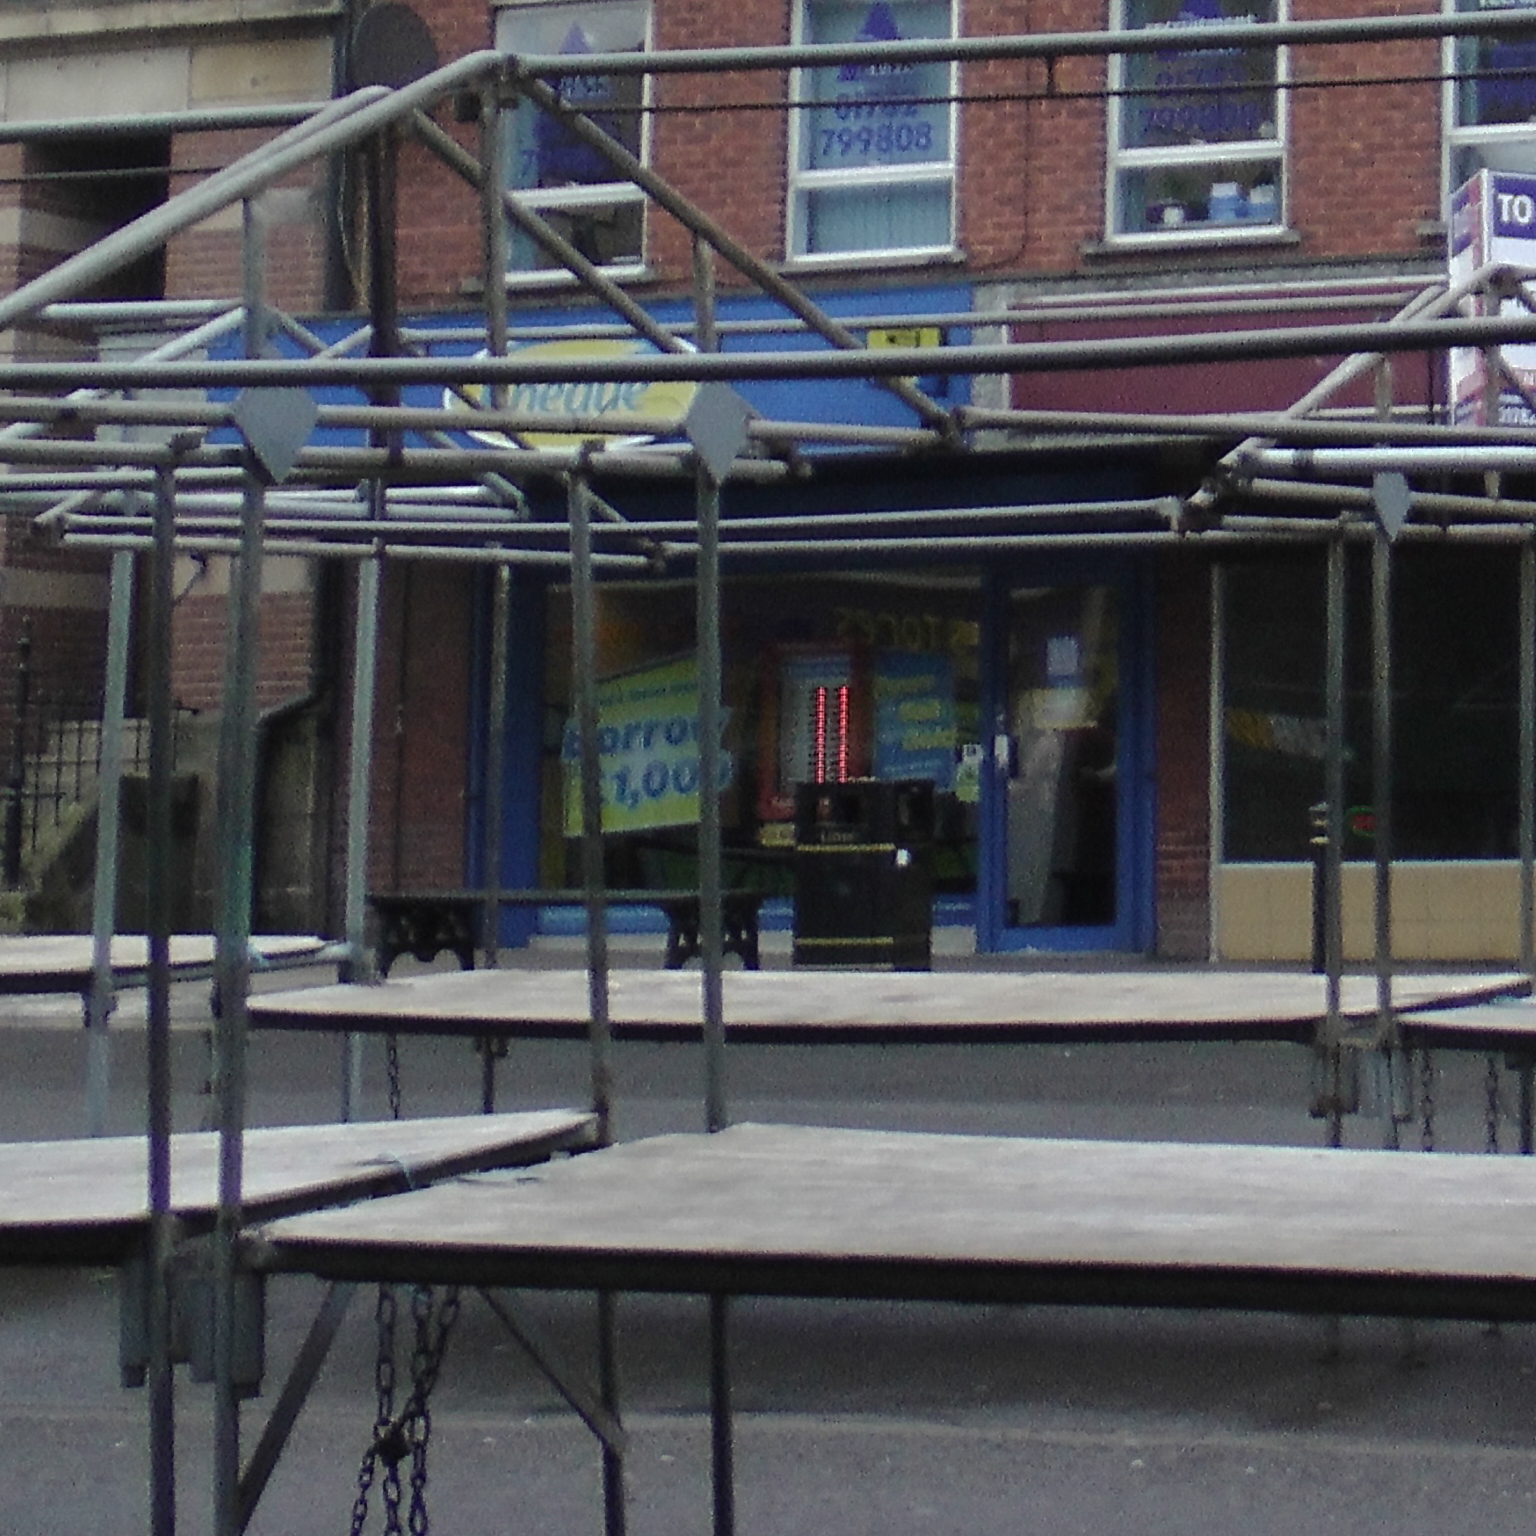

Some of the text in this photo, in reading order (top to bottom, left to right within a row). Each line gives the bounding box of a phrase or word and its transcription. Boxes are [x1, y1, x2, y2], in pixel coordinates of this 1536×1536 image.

[821, 120, 933, 156] 799808
[1498, 193, 1532, 224] TO
[601, 749, 732, 811] 1,00
